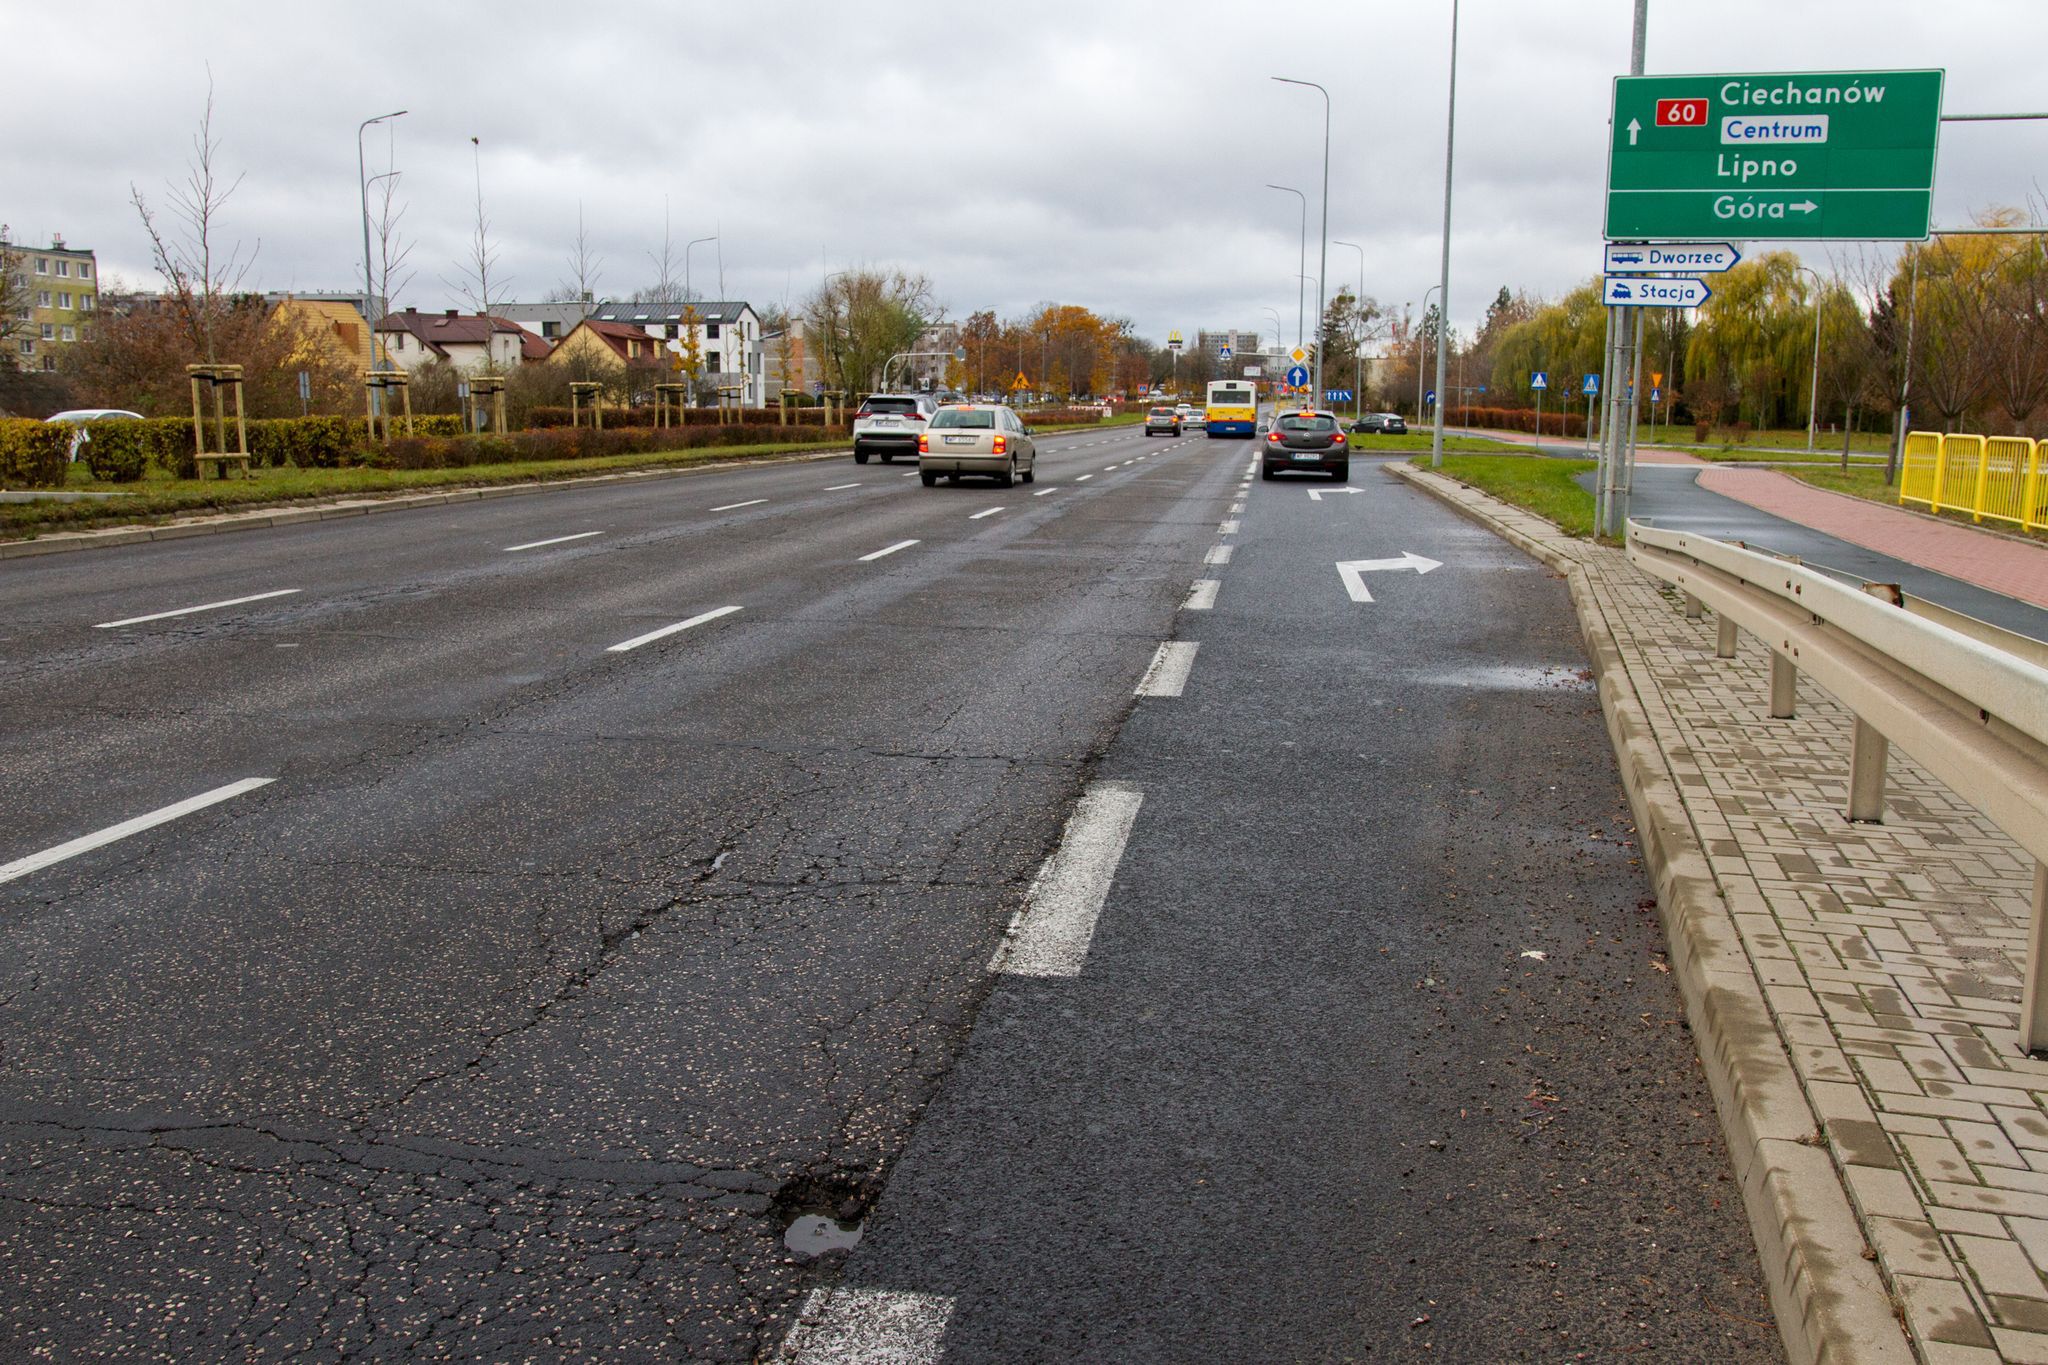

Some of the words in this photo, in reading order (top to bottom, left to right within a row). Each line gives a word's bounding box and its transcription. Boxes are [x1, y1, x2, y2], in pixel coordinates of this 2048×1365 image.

[1720, 80, 1885, 105] Ciechanów
[1667, 104, 1696, 122] 60
[1727, 121, 1822, 138] Centrum
[1717, 153, 1798, 183] Lipno
[1713, 195, 1784, 219] Góra
[1649, 250, 1724, 265] Dworzec
[1639, 284, 1696, 301] Stacja
